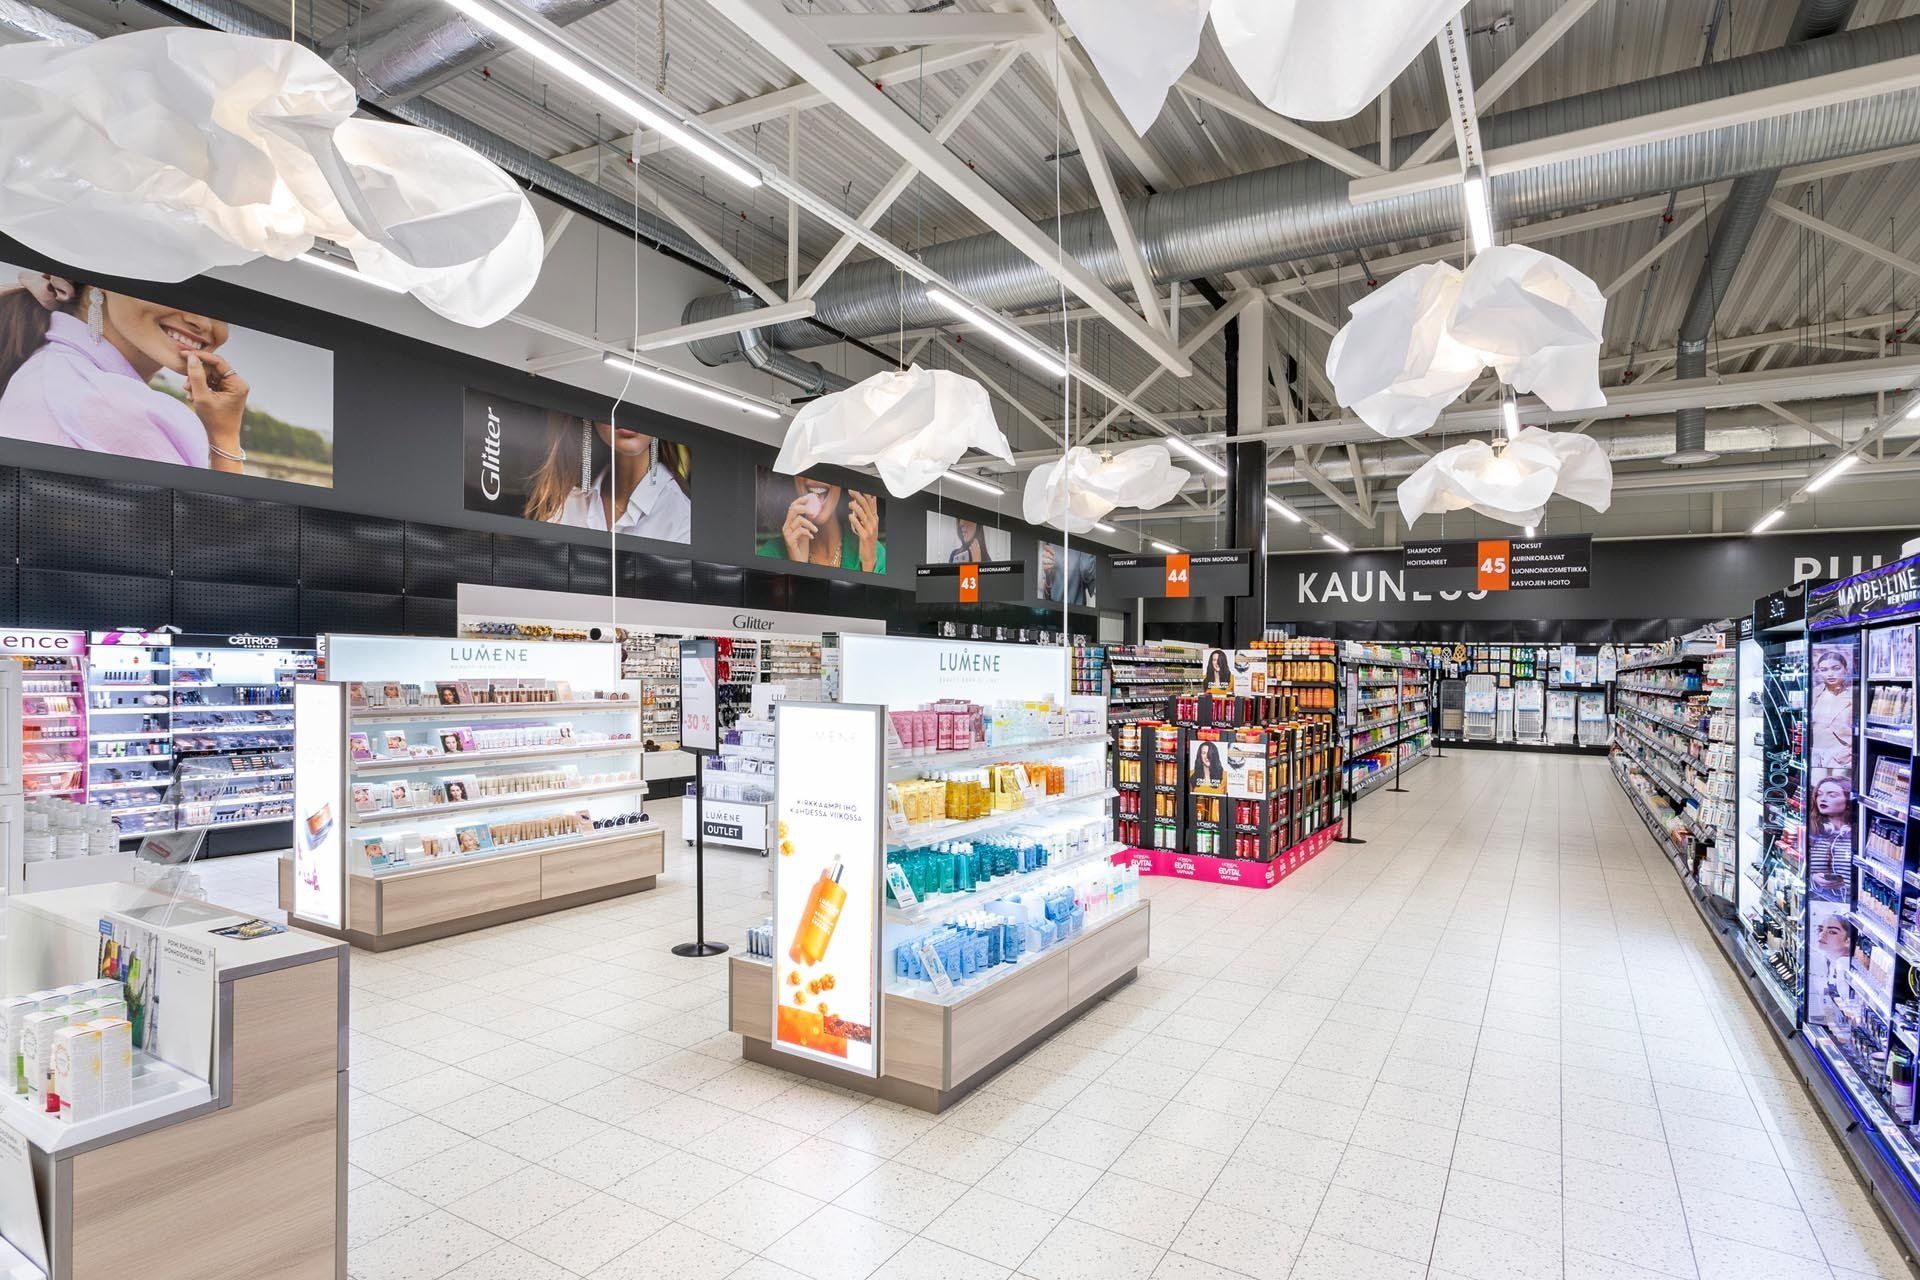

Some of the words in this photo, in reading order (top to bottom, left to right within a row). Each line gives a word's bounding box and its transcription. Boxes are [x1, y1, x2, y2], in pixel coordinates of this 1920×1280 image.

[481, 406, 501, 501] Glitter
[1512, 542, 1542, 550] TUOKSUT
[1406, 559, 1448, 567] HOITOAINEET
[1511, 554, 1565, 562] AURINKORASVAT
[1480, 557, 1507, 574] 45
[1511, 566, 1588, 575] LUONNONKOSMETIIKKA
[1168, 569, 1188, 583] 44
[961, 577, 977, 590] 43
[1297, 570, 1489, 603] KAUN
[1838, 568, 1918, 606] MAYBELLINE
[1887, 593, 1900, 605] NEW
[1901, 590, 1916, 604] YORK
[732, 614, 775, 630] Glitter
[451, 644, 528, 662] LUMENE
[940, 648, 1001, 672] LUMENE
[705, 810, 740, 823] LUMENE
[707, 824, 739, 837] OUTLET
[1131, 858, 1153, 867] ELVITAL
[1174, 861, 1197, 871] ELVITAL
[1218, 867, 1242, 877] ELVITAL
